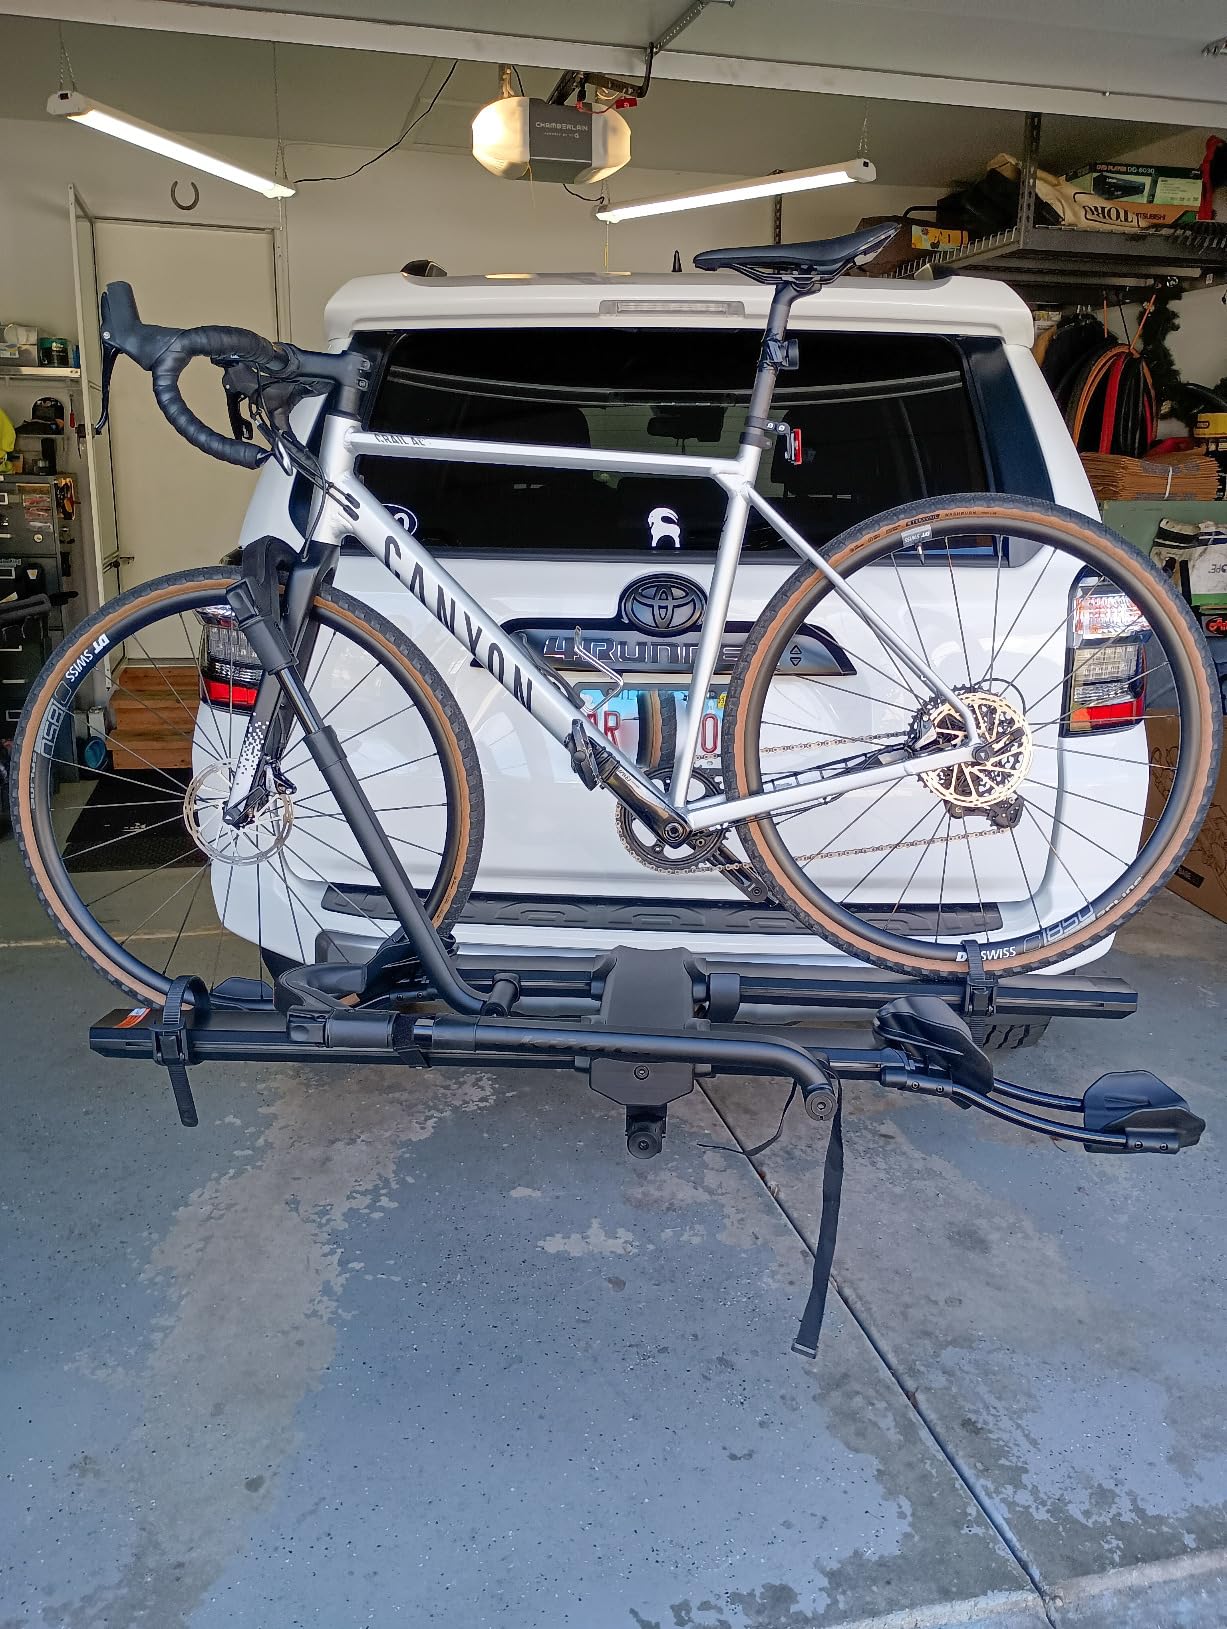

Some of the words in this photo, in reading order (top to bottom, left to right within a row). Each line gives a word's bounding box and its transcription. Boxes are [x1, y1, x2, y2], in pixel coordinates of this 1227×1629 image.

[535, 121, 589, 131] CHAMBERLAIN
[384, 535, 533, 713] CANYON
[92, 633, 111, 654] DT
[544, 637, 743, 664] 4RUNE
[65, 649, 94, 682] SWISS
[980, 946, 1017, 961] SWISS
